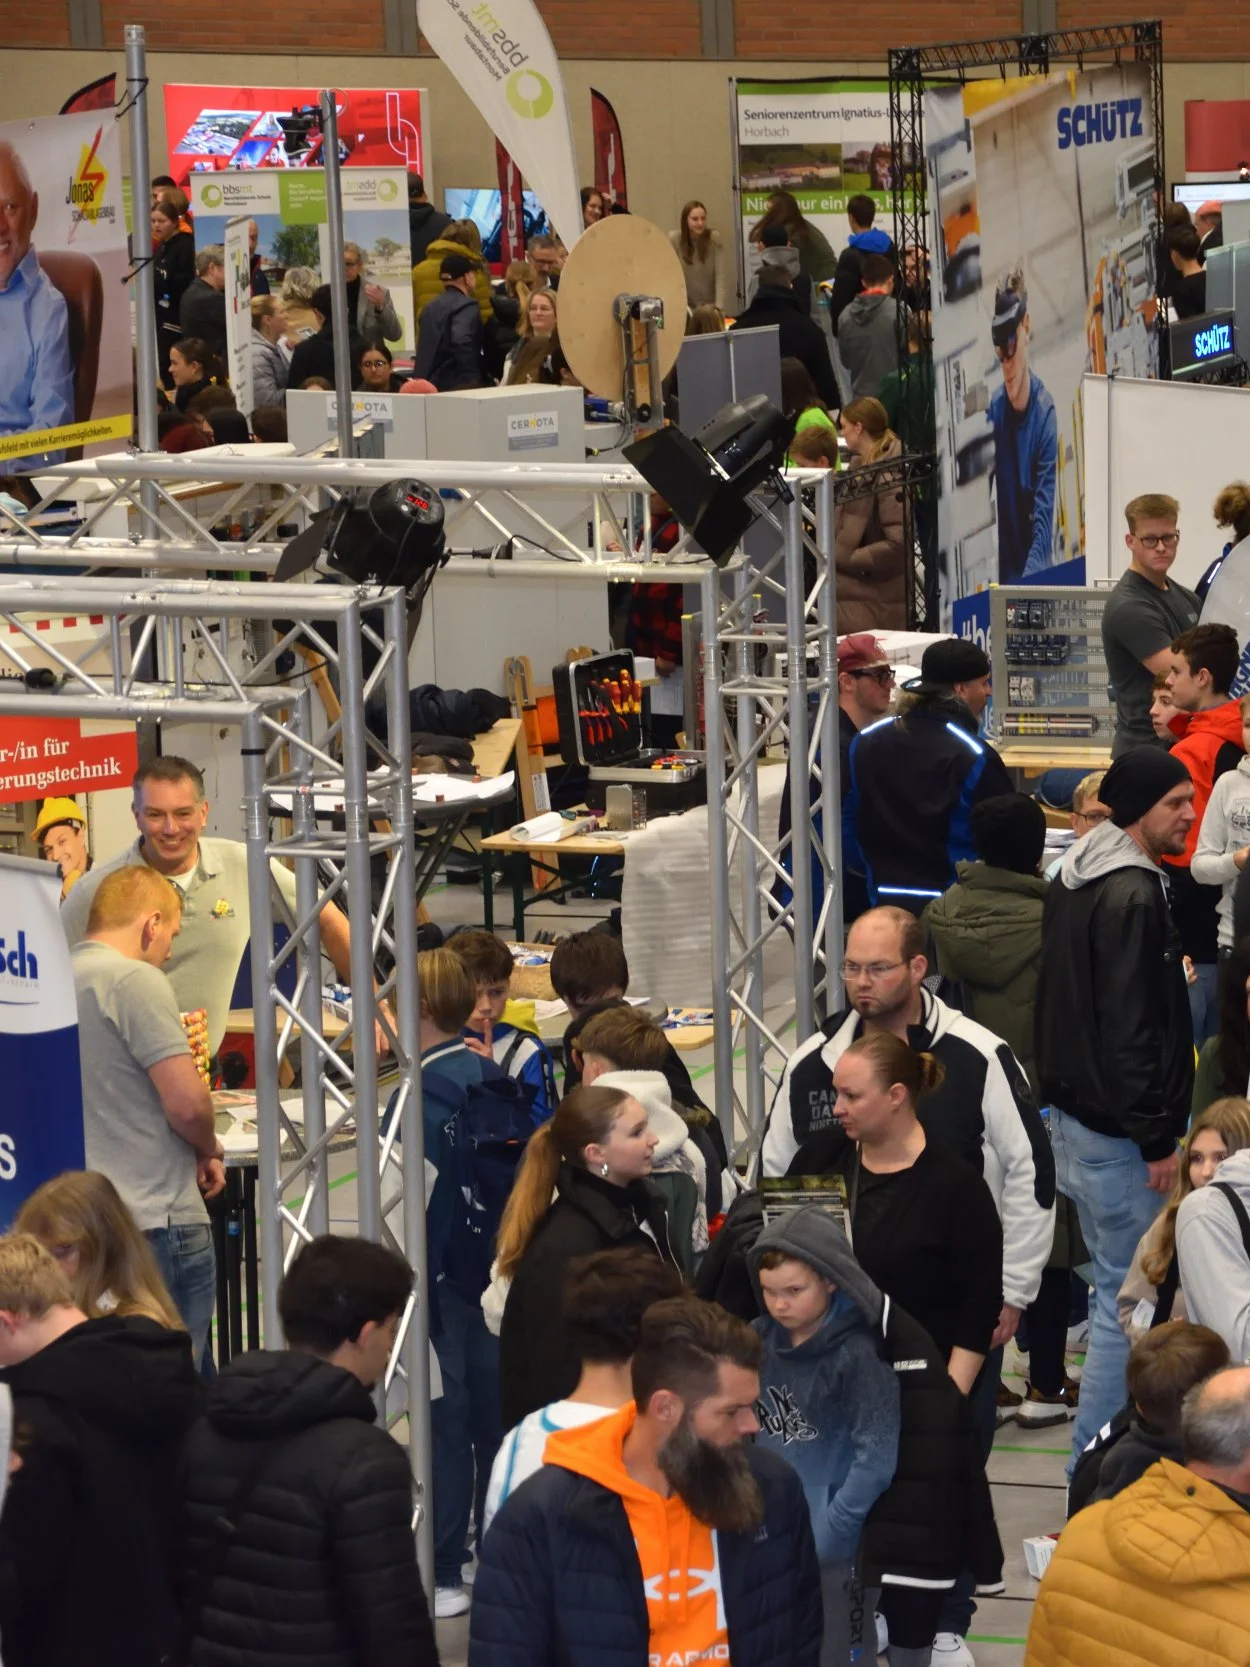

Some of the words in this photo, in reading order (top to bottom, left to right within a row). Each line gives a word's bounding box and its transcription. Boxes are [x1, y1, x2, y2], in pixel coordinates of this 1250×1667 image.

[744, 109, 840, 121] Seniorenzentrum
[1057, 97, 1143, 149] SCHÜTZ
[745, 126, 790, 138] Horbach
[66, 176, 95, 204] Jonas
[222, 183, 253, 195] bbsmt
[1195, 323, 1231, 358] SCHÜTZ
[43, 737, 70, 757] für
